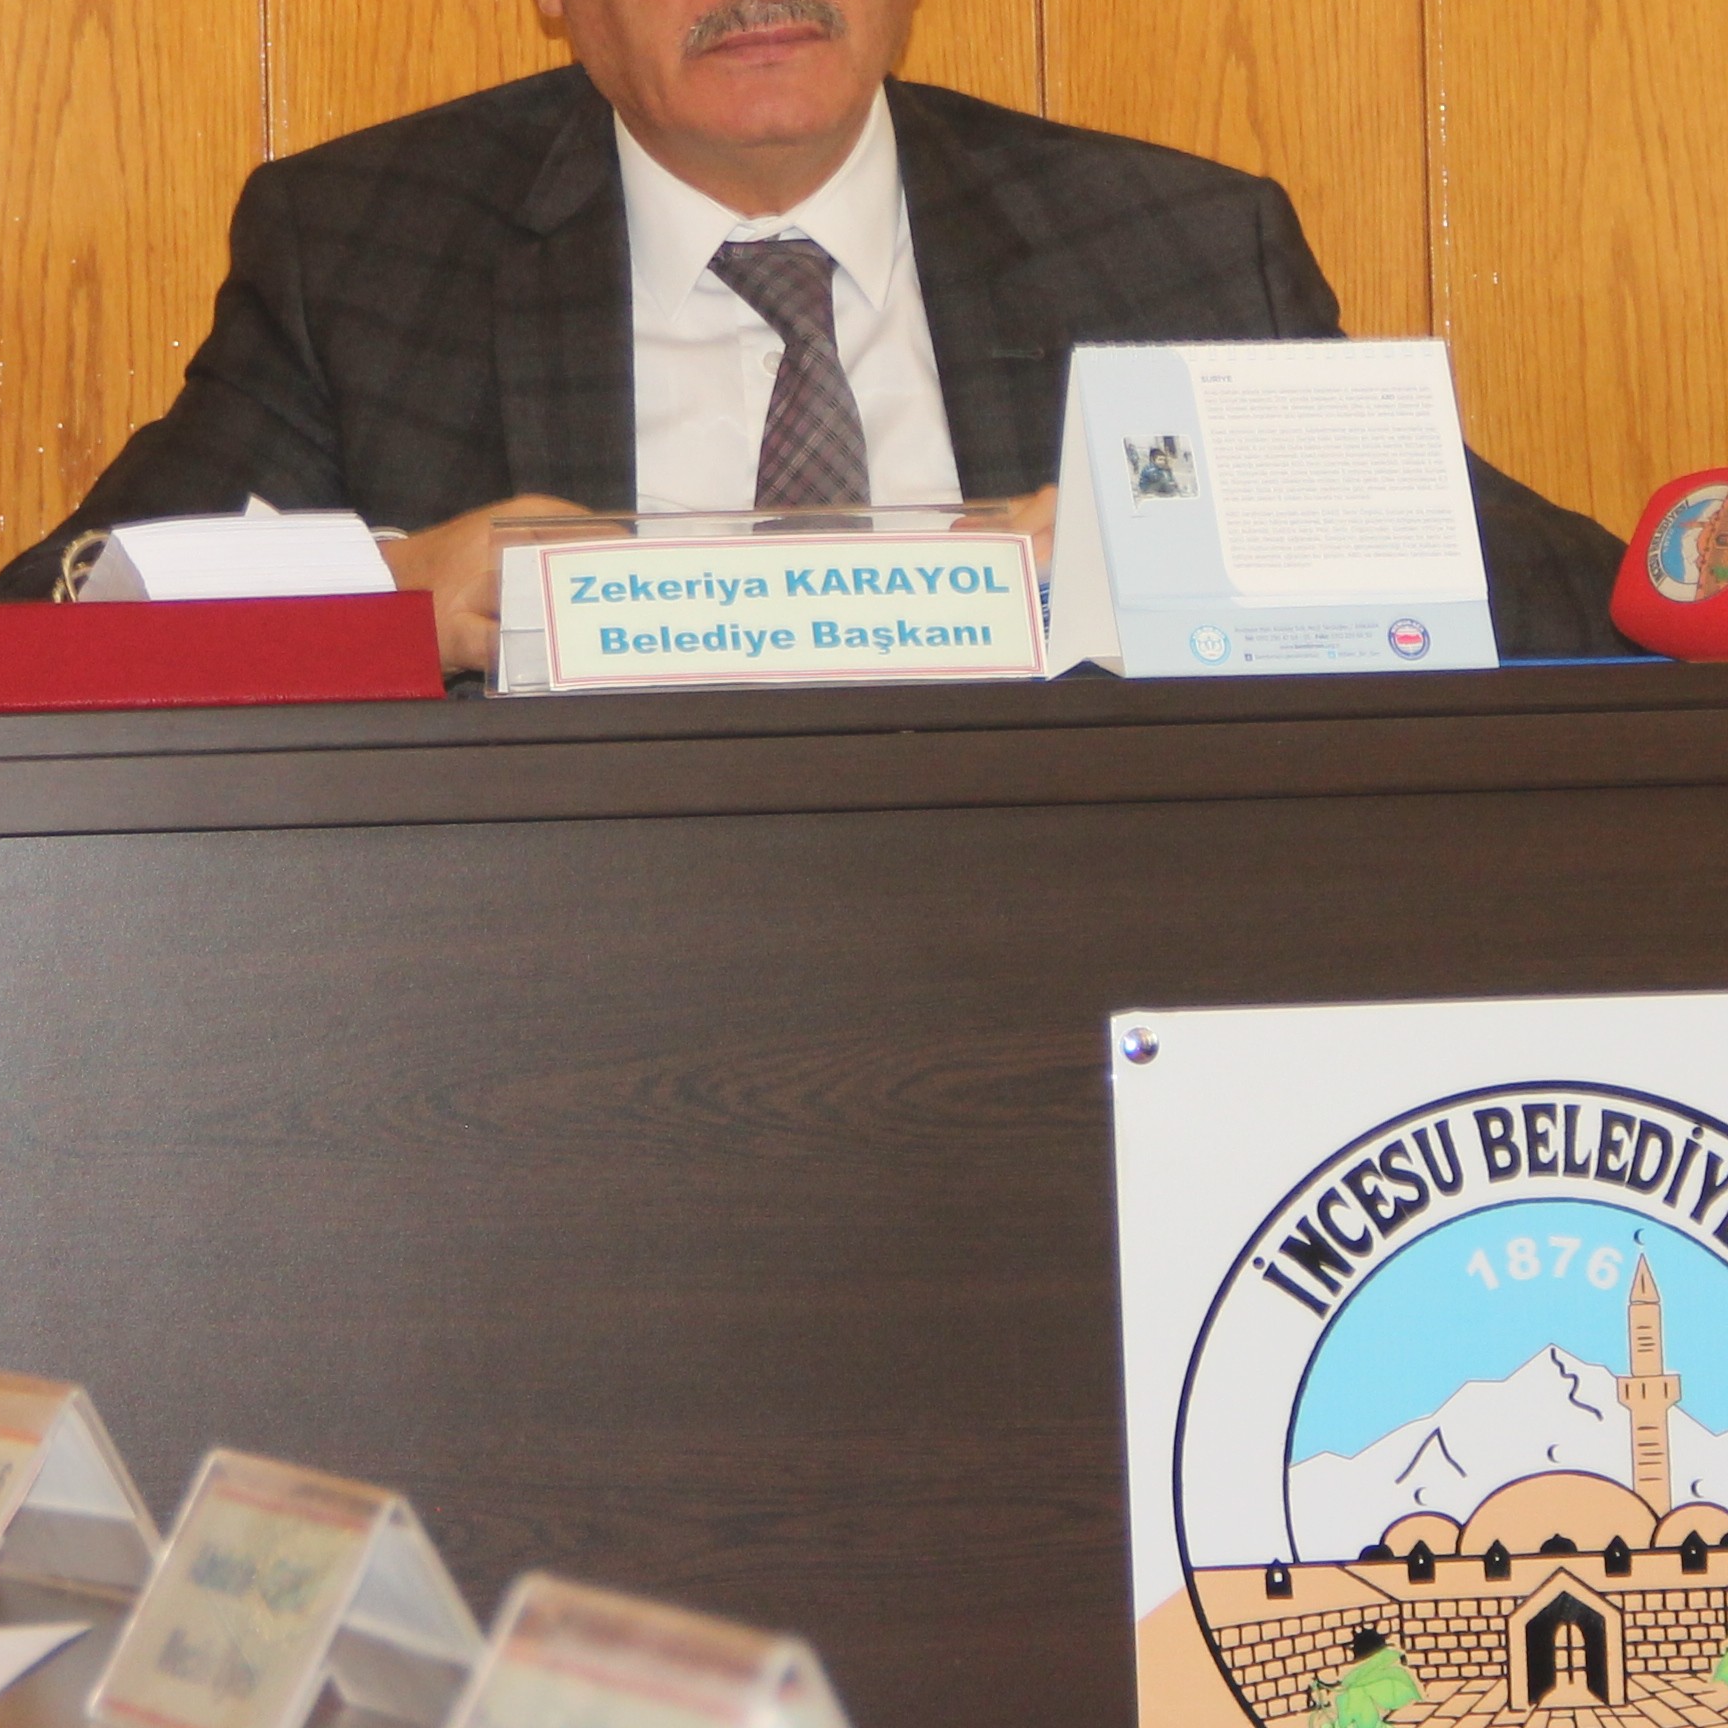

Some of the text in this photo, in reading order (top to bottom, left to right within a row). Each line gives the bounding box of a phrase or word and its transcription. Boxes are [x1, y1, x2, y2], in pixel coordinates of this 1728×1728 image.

[570, 565, 1010, 607] Zekeriya KARAYOL
[599, 617, 993, 658] Belediye Başkanı
[1252, 1118, 1465, 1320] İNCESU
[1466, 1235, 1624, 1291] 1876
